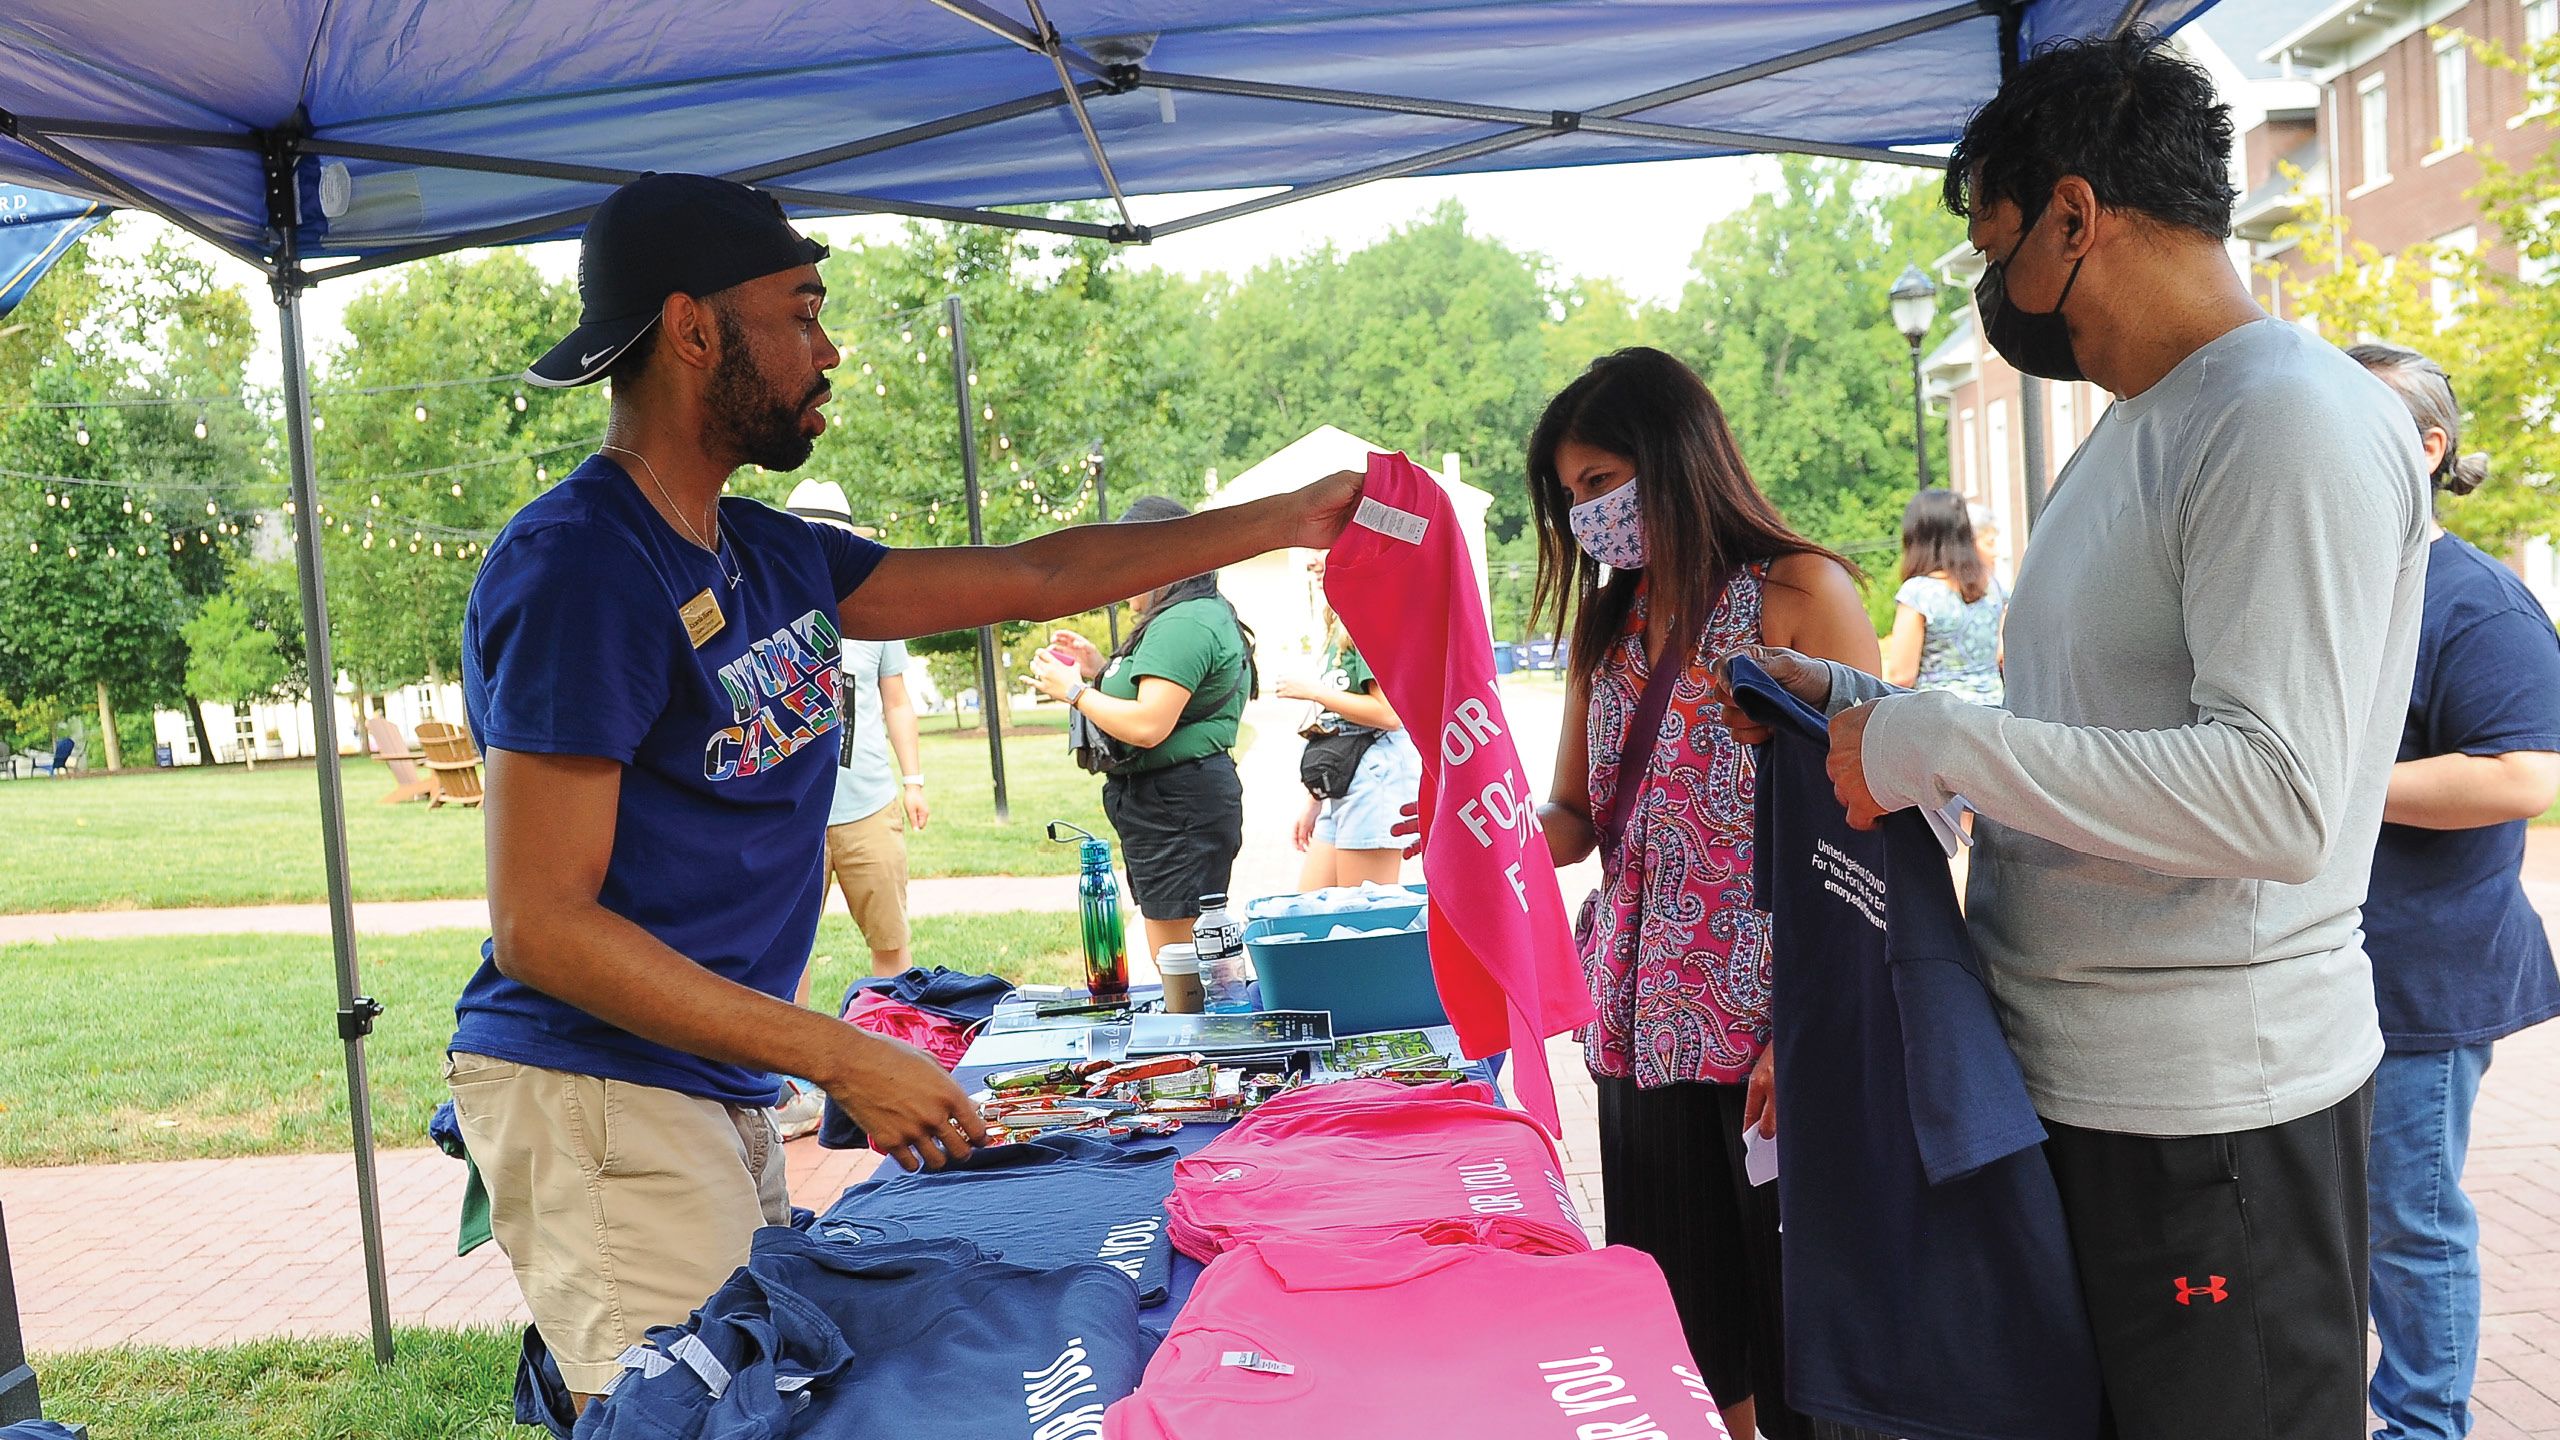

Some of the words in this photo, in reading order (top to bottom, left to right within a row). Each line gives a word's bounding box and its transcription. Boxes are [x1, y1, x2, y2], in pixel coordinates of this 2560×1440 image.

[717, 609, 842, 724] OORD
[1811, 854, 1828, 871] For
[1817, 838, 1842, 862] United
[1458, 1158, 1515, 1192] YOU.
[1468, 1192, 1529, 1217] OR
[1097, 1215, 1162, 1258] YOU.
[1023, 1337, 1098, 1424] YOU.
[1537, 1346, 1638, 1417] YOU.
